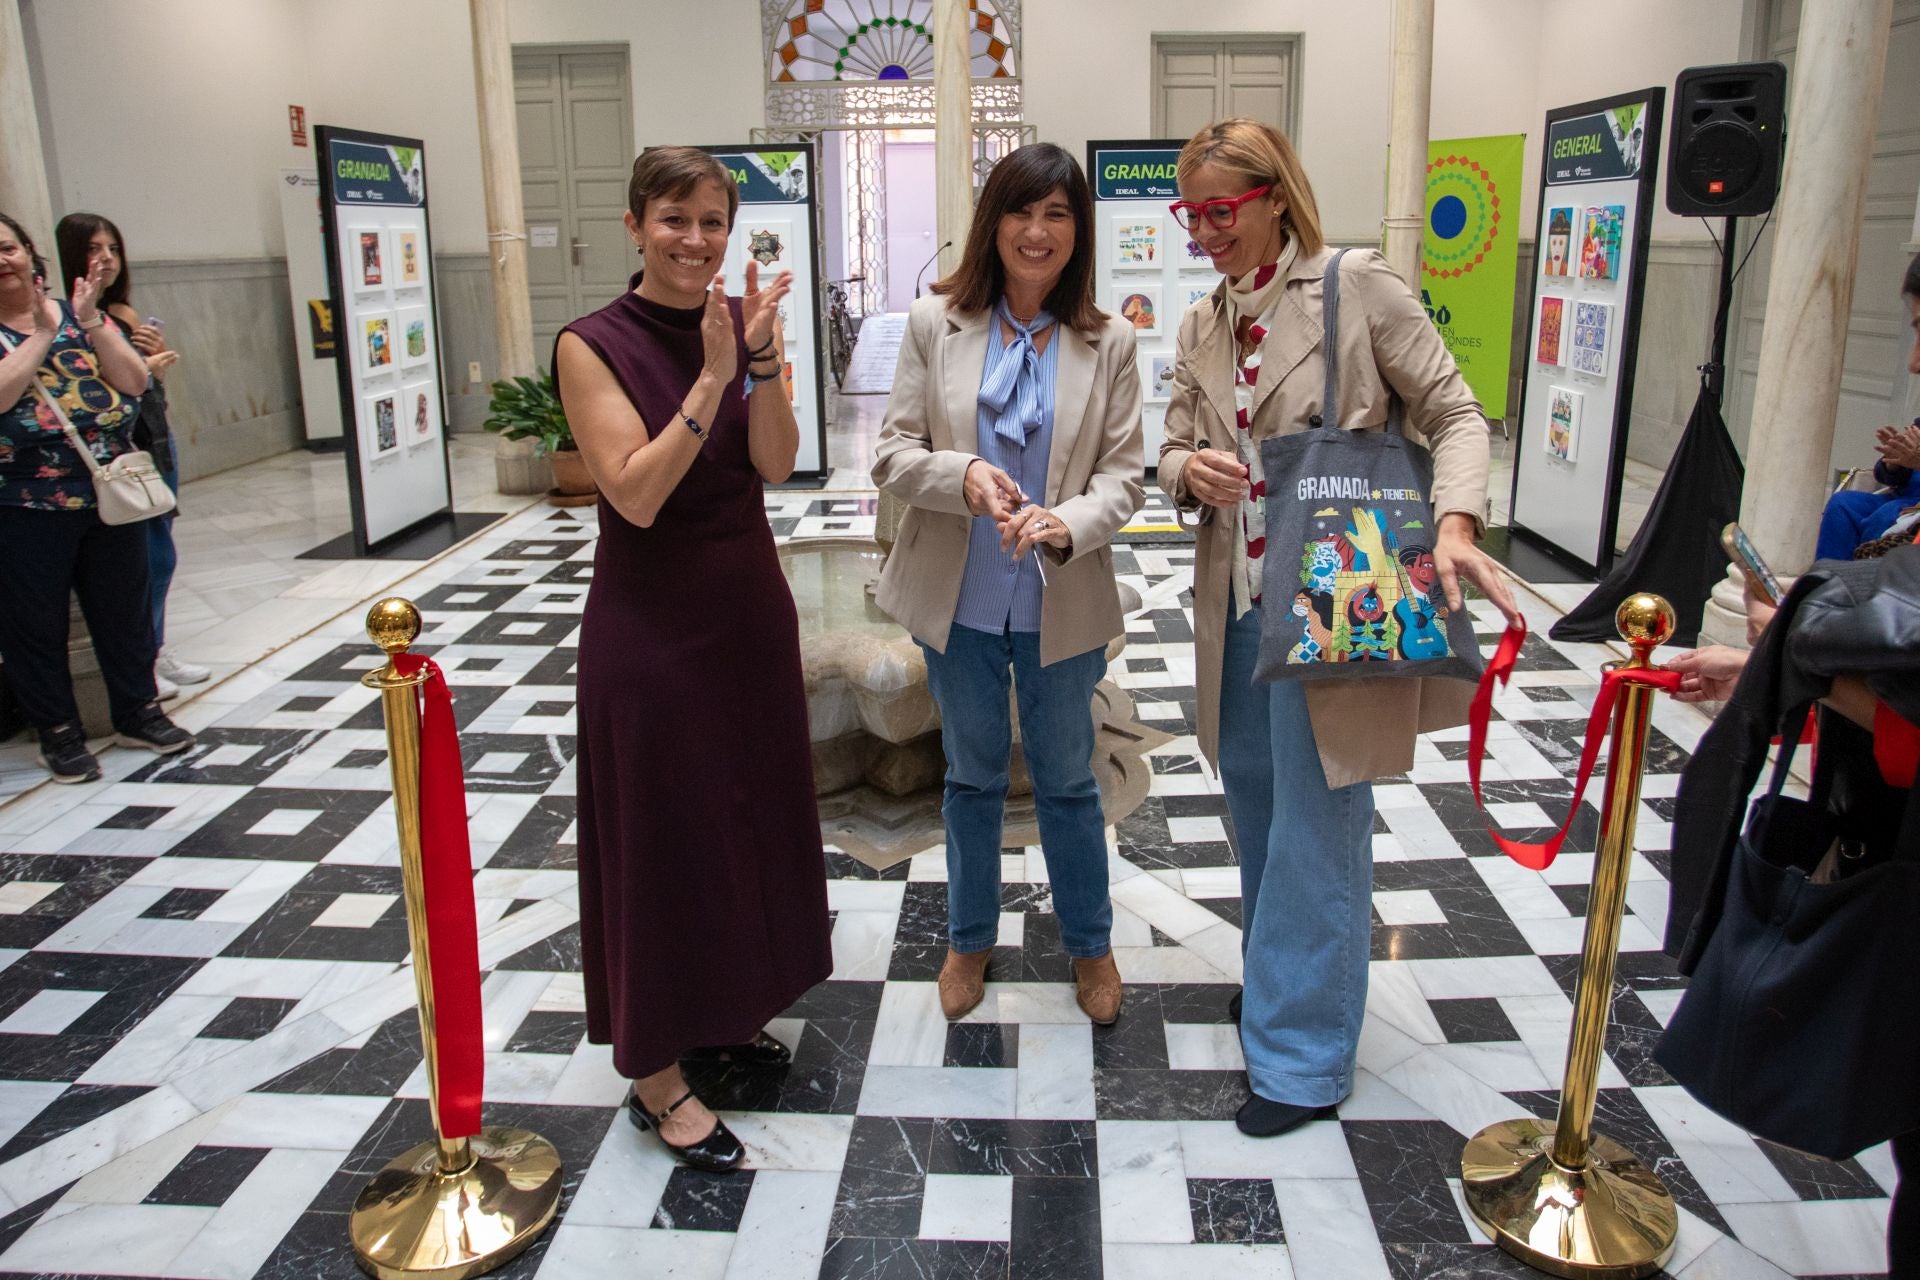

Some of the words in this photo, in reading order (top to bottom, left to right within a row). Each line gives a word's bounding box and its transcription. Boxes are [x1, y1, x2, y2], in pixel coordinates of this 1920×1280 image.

[1553, 133, 1602, 159] GENERAL
[337, 159, 391, 182] GRANADA
[1104, 163, 1178, 180] GRANAD
[1446, 336, 1482, 347] ONDES
[1297, 476, 1371, 501] GRANADA
